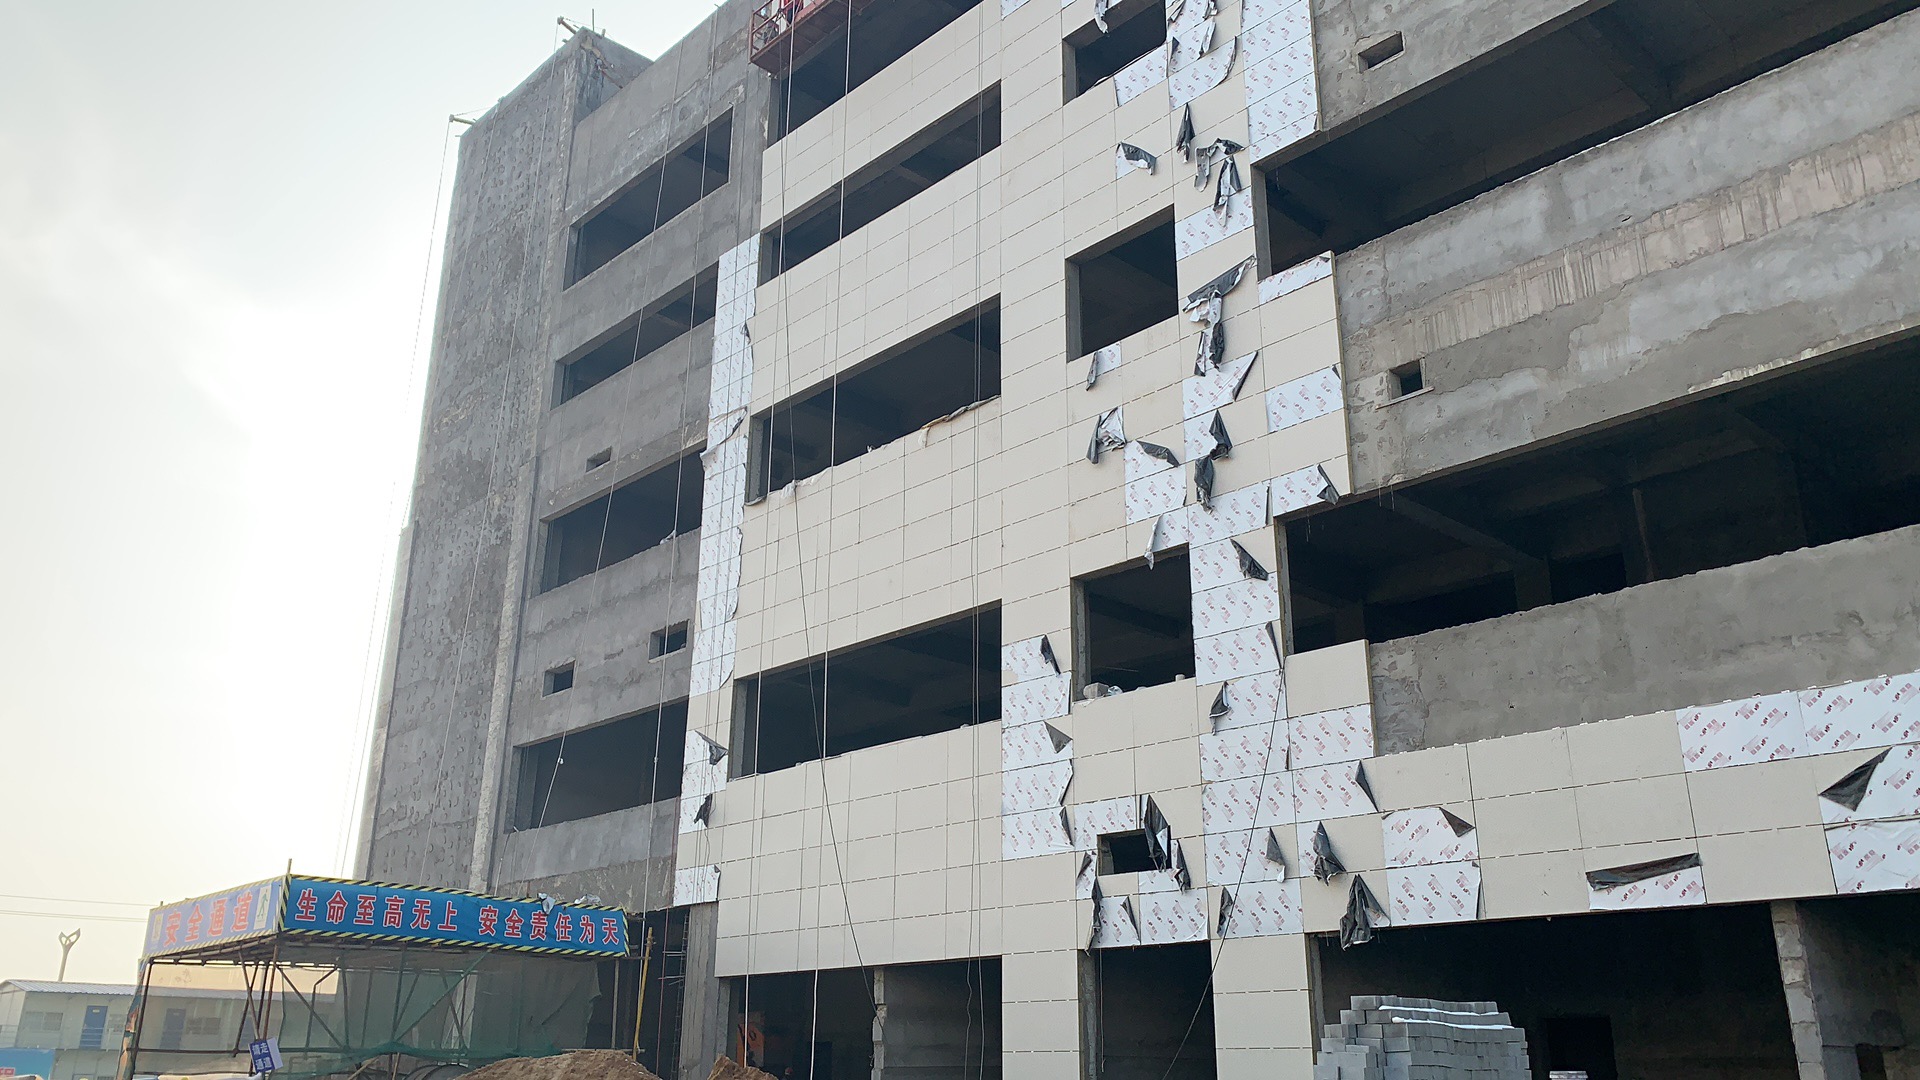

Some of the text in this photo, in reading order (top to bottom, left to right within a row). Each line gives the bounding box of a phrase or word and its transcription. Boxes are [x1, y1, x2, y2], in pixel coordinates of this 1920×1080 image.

[163, 889, 253, 948] 安全通道
[295, 888, 619, 946] 生命至高无上 安全责任为天
